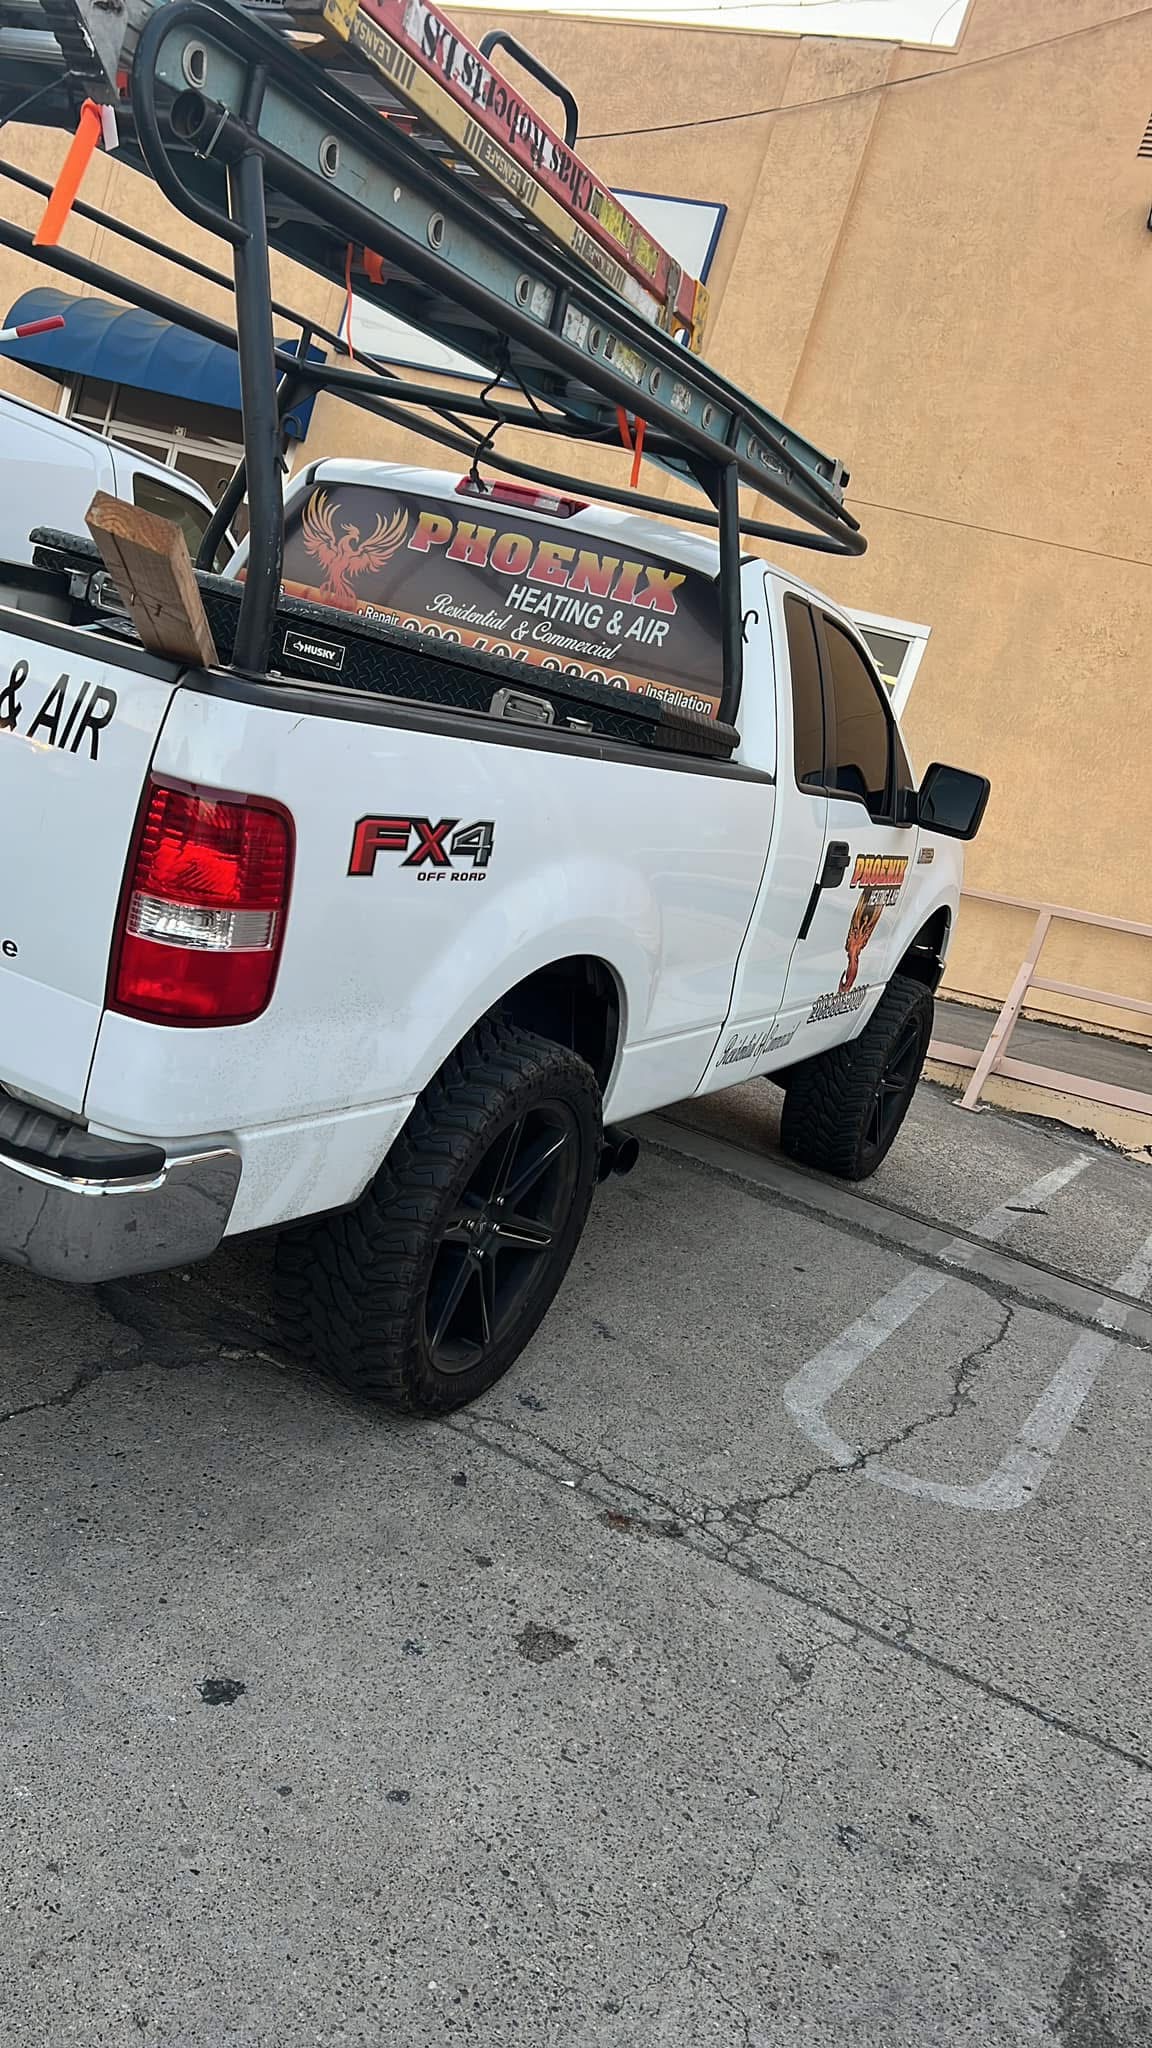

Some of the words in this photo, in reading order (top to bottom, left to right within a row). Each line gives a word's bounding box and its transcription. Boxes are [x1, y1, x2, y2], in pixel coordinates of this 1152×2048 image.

[460, 52, 549, 168] Roberts
[550, 142, 594, 213] Chas
[408, 511, 687, 615] PHOENIX
[425, 593, 513, 631] Residential
[510, 621, 530, 641] &
[532, 621, 623, 660] Commercial
[505, 583, 604, 629] HEATING
[606, 609, 623, 636] &
[624, 615, 670, 647] AIR
[303, 643, 336, 661] HUSKY
[26, 673, 118, 761] AIR
[645, 683, 713, 716] Installation
[347, 812, 495, 877] FX4
[416, 871, 447, 882] OFF
[450, 871, 487, 882] ROAD
